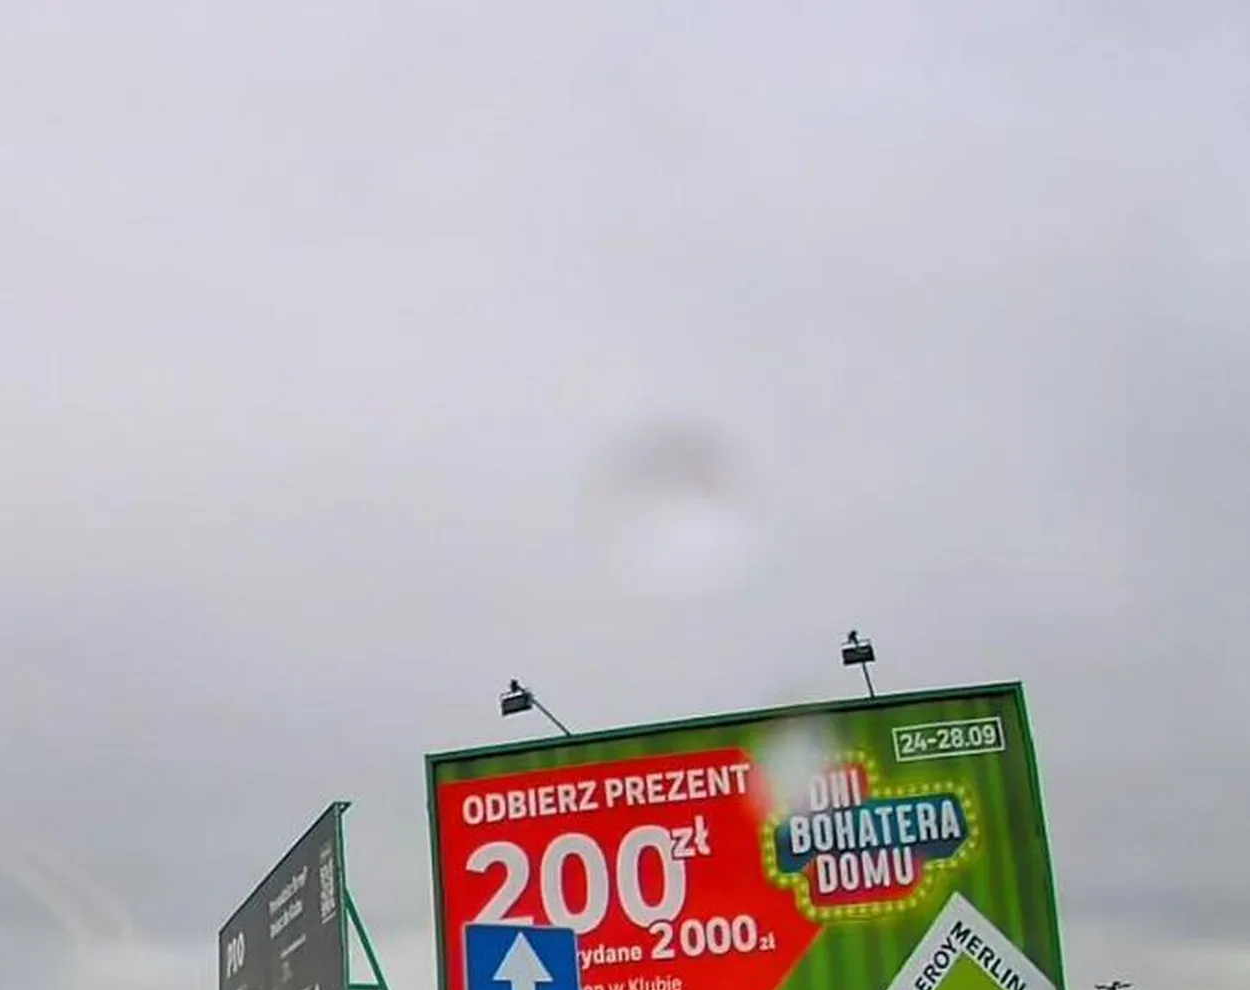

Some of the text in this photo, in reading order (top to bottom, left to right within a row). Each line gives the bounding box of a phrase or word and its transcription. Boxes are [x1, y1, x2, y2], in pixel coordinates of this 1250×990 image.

[900, 724, 997, 754] 24-28.09
[462, 763, 750, 825] ODBIERZ PREZENT
[810, 768, 862, 811] DNI
[789, 799, 962, 854] BOHATERA
[465, 814, 711, 935] 200 zł
[816, 847, 915, 894] DOMU
[578, 944, 643, 970] ydane
